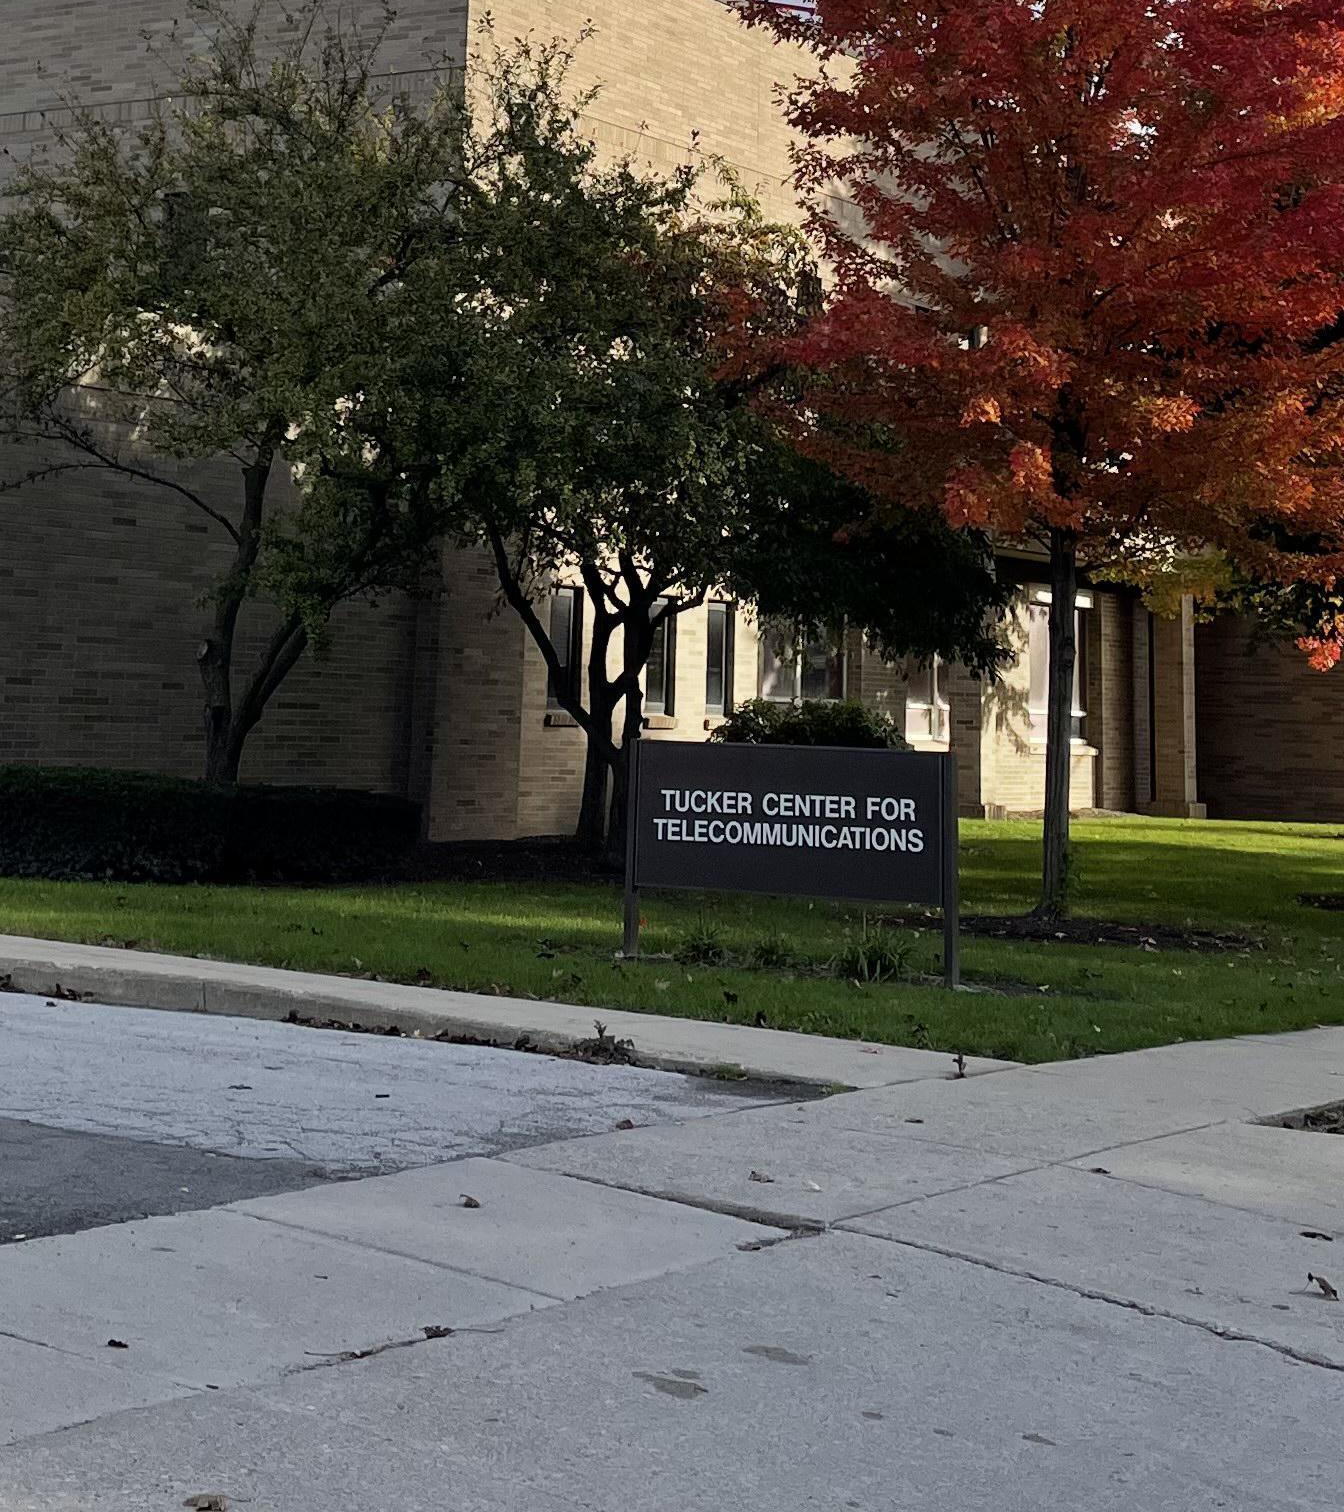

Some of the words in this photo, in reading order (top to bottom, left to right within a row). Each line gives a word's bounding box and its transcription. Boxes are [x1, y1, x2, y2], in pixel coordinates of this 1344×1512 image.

[661, 789, 752, 815] TUCKER
[762, 792, 856, 819] CENTER
[867, 796, 916, 822] FOR
[653, 818, 924, 853] TELECOMMUNICATIONS
